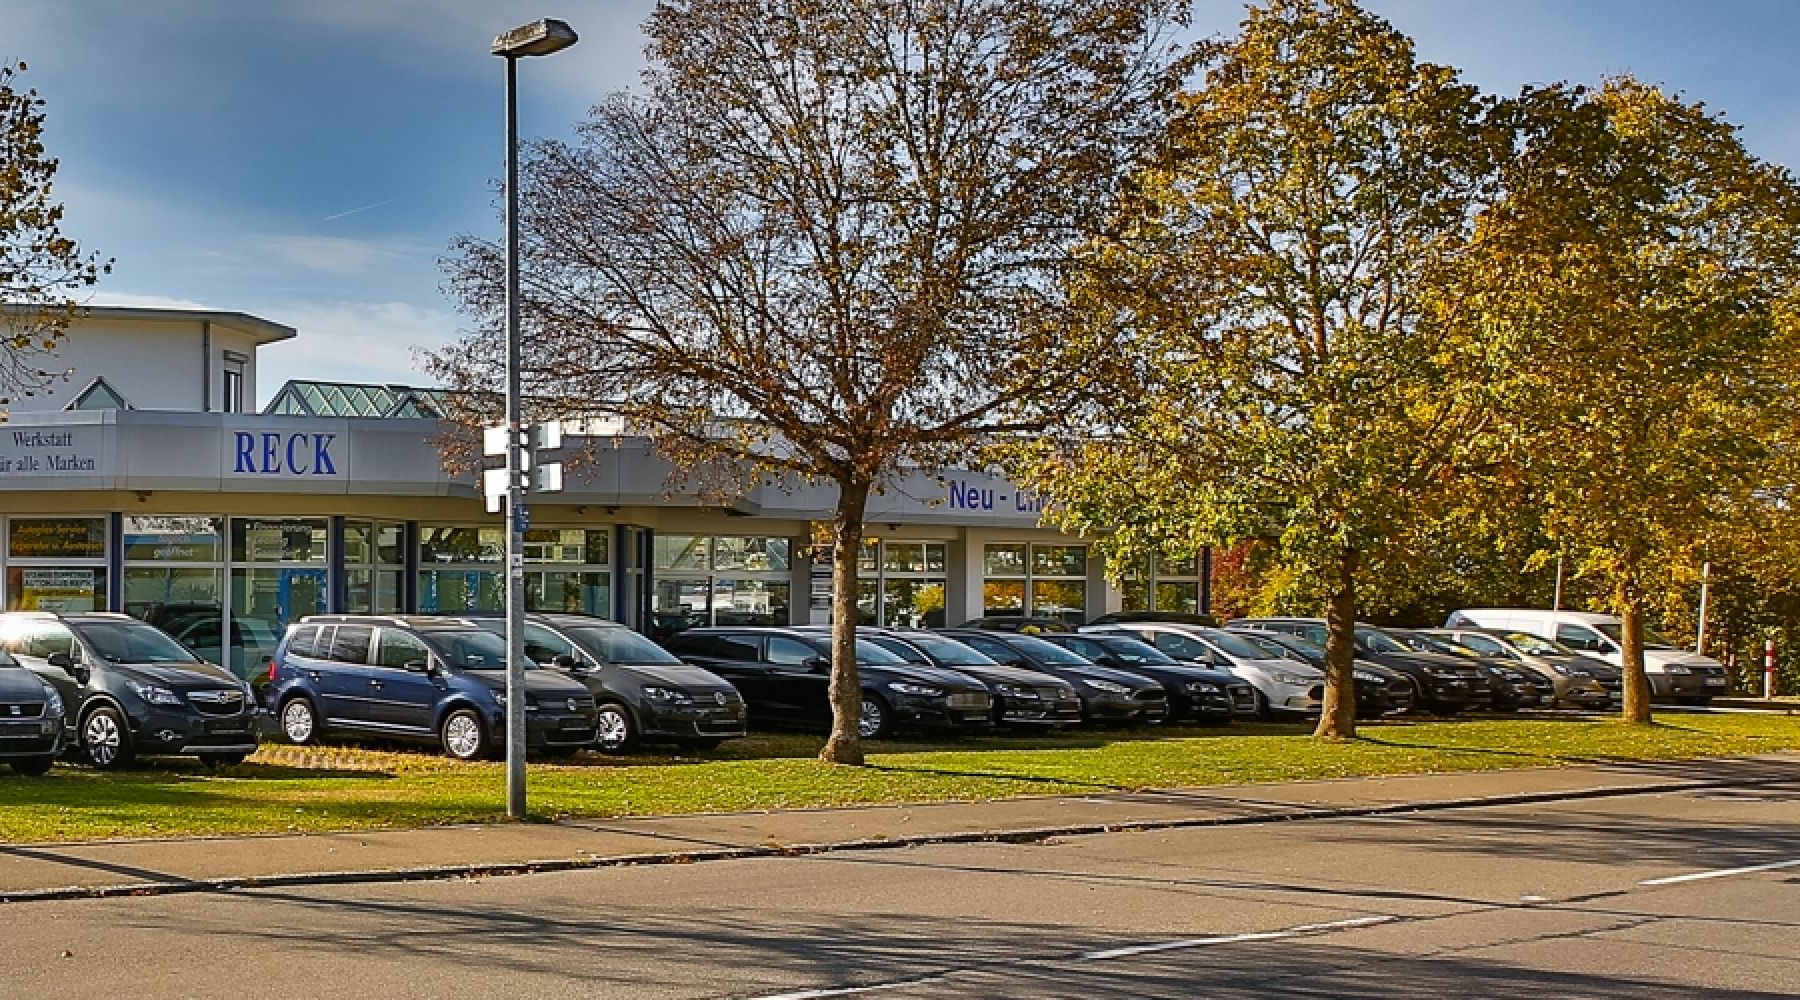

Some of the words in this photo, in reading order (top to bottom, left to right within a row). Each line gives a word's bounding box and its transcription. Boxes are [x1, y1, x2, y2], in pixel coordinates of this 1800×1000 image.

[12, 431, 72, 447] Werkstatt
[233, 431, 337, 475] RECK
[15, 455, 38, 471] alle
[46, 455, 95, 471] Marken
